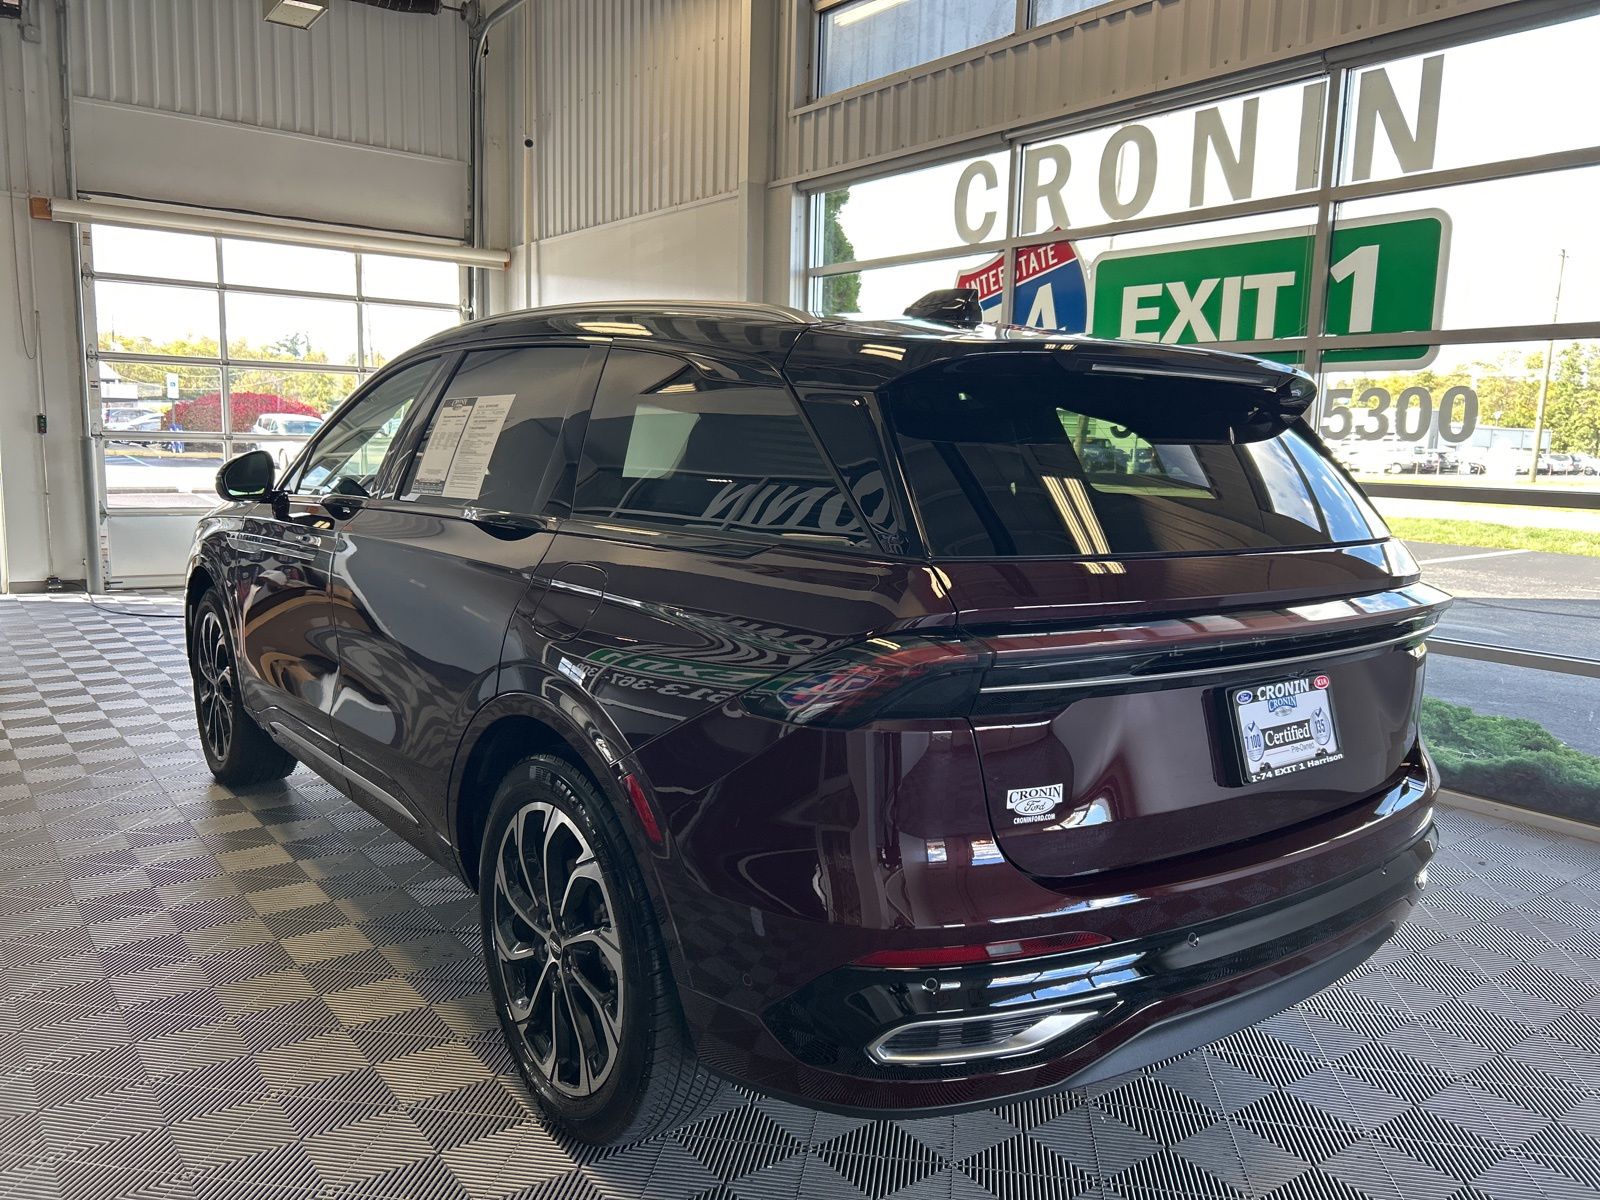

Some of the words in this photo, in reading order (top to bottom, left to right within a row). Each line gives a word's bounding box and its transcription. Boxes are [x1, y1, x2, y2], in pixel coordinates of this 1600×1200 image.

[954, 54, 1445, 244] CRONIN
[966, 243, 1058, 297] NTERTATE
[1119, 271, 1296, 344] EXIT
[1329, 244, 1380, 334] 1
[1320, 386, 1479, 443] 5300
[1257, 679, 1310, 701] CRONIN
[1269, 696, 1297, 711] CRONIN
[1264, 722, 1311, 747] Certified
[1252, 771, 1273, 783] I-74
[1274, 765, 1297, 777] EXIT
[1299, 762, 1305, 770] 1
[1307, 754, 1343, 767] Harrison
[1009, 786, 1061, 804] CRONIN
[1023, 799, 1045, 811] Ford
